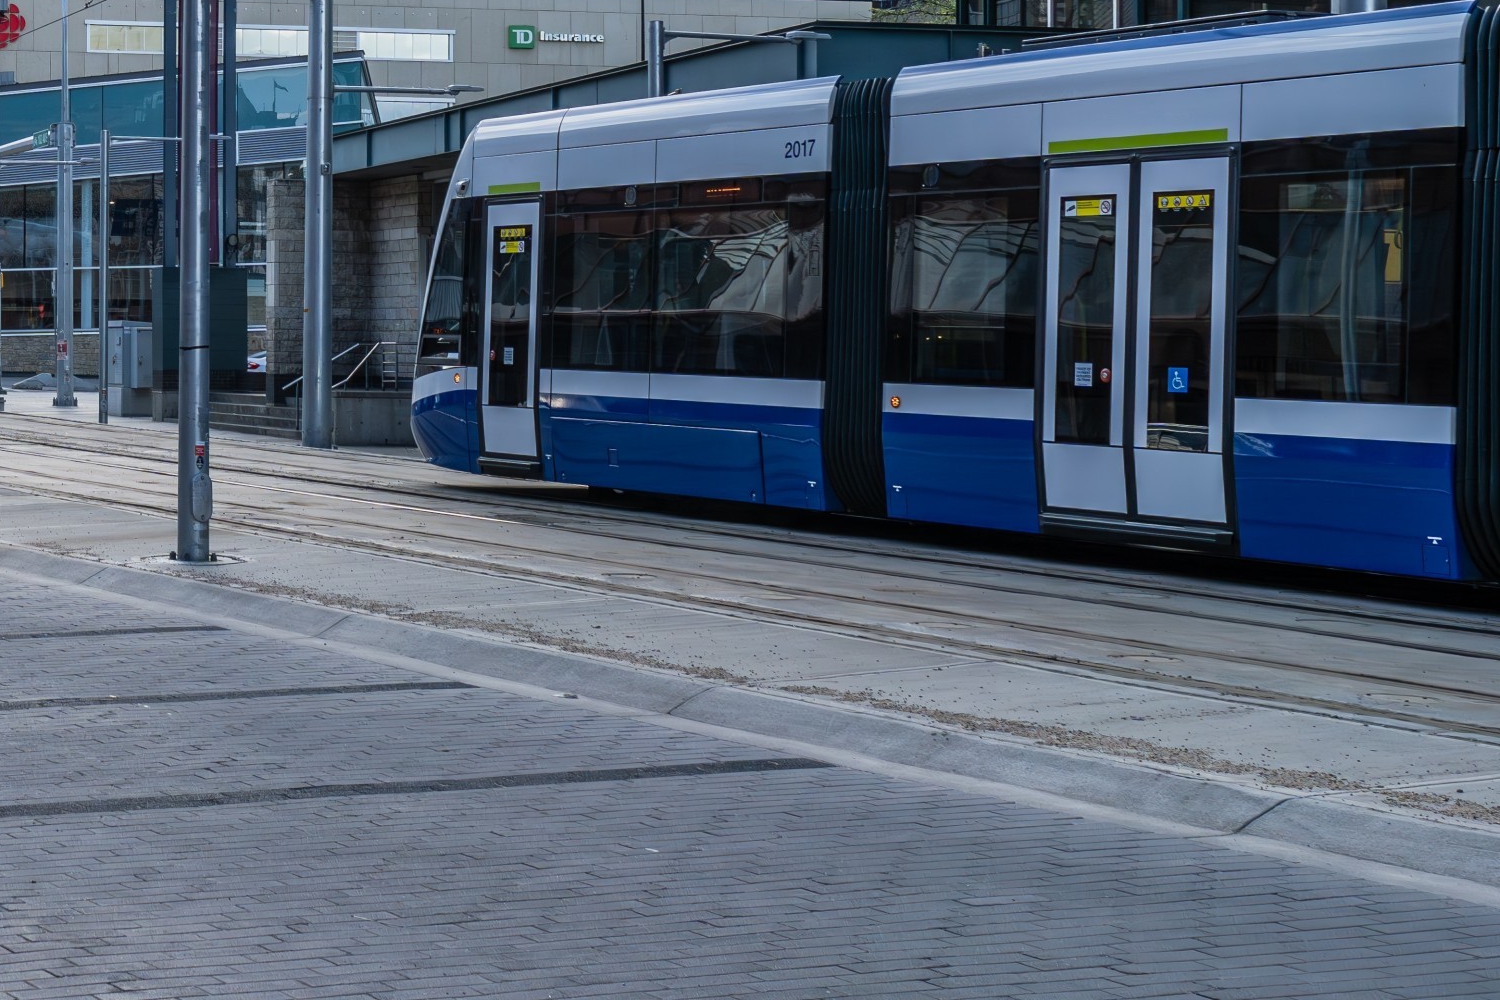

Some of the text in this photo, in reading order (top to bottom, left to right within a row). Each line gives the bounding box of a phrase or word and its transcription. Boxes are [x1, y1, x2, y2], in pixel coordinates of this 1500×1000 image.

[512, 29, 605, 44] TD Insurance
[784, 138, 816, 159] 2017
